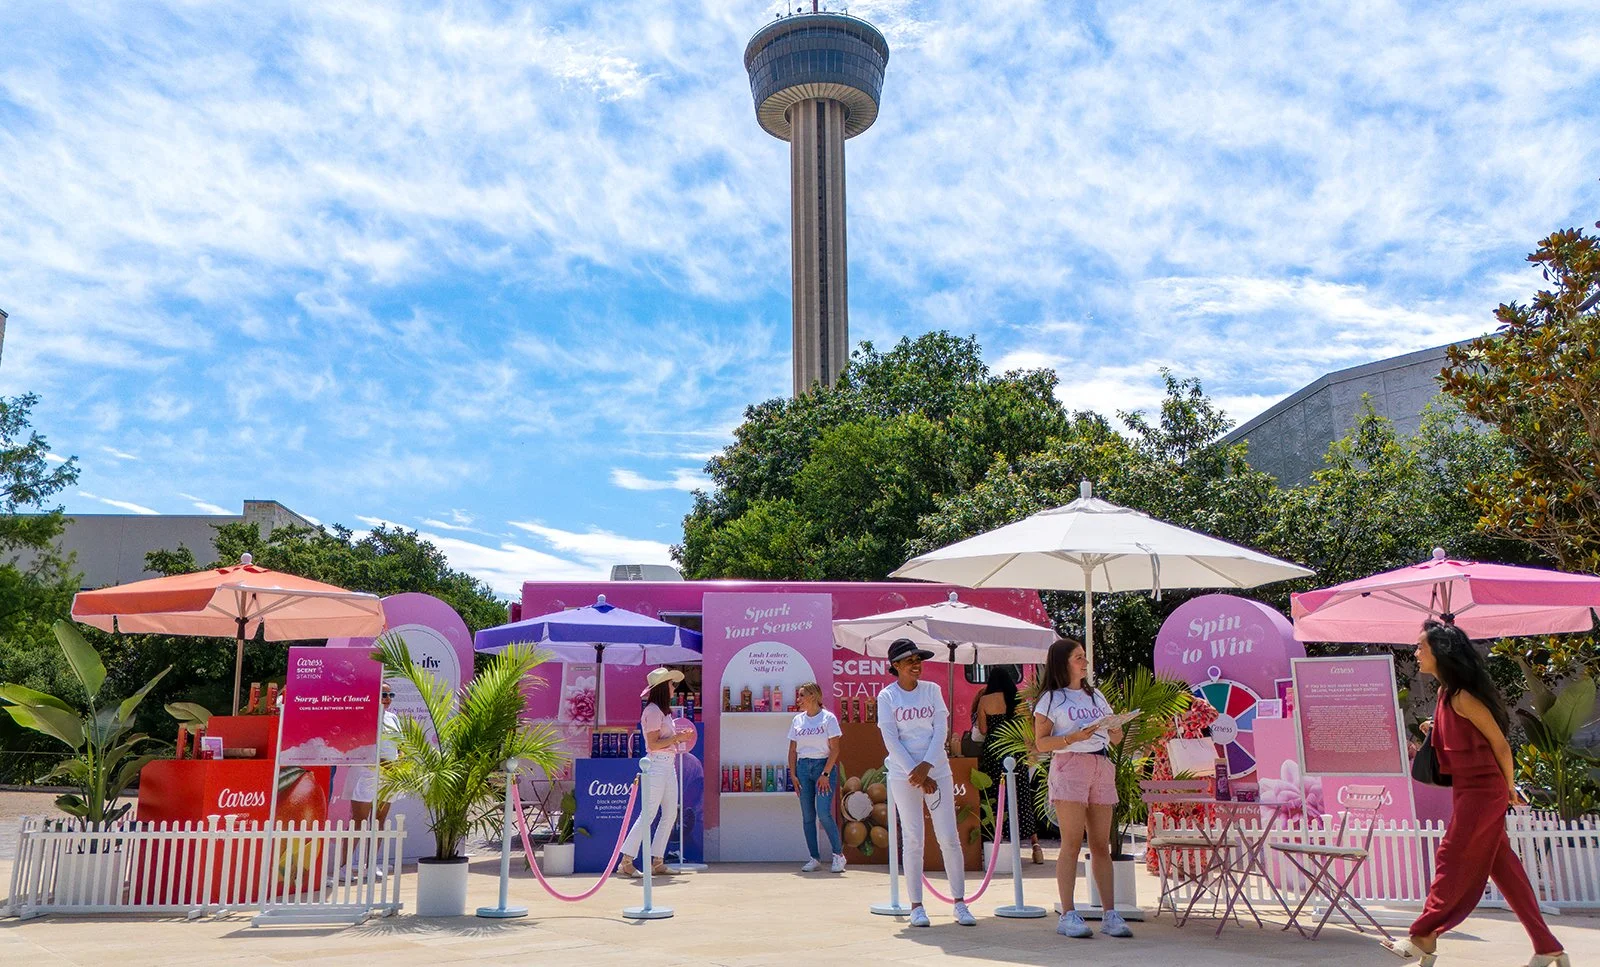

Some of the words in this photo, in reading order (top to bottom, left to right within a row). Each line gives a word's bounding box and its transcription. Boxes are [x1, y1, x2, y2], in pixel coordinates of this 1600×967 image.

[744, 603, 790, 622] Spark
[724, 625, 759, 639] Your
[762, 620, 813, 635] Senses
[1188, 614, 1241, 641] Spin
[1182, 648, 1202, 664] to
[1210, 637, 1254, 659] Win
[296, 657, 323, 667] Caress
[832, 682, 885, 698] STAT
[294, 695, 319, 704] Sorry,
[321, 695, 342, 703] We're
[343, 695, 371, 703] Closed.
[895, 706, 936, 722] Cares
[1068, 706, 1107, 721] Cares
[1211, 724, 1233, 733] Caress
[218, 788, 266, 808] Caress
[1337, 785, 1393, 805] Css
